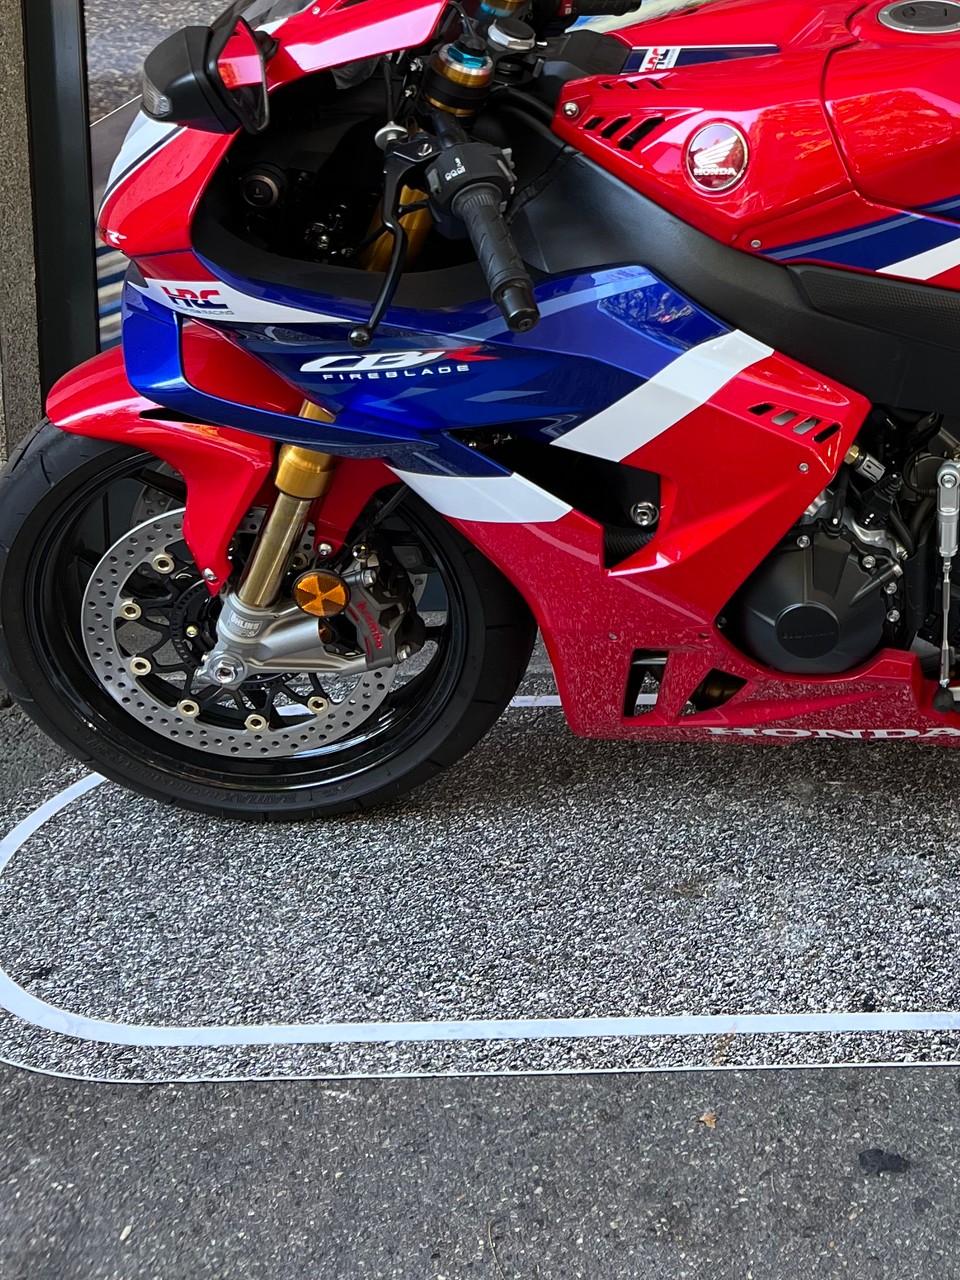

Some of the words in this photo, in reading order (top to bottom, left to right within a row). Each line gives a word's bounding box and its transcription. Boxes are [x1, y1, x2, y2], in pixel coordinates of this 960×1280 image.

[693, 167, 738, 177] HONDA
[161, 286, 229, 310] HRC
[299, 345, 503, 372] CBR
[322, 363, 471, 380] FIREBLADE
[356, 601, 385, 649] brembo
